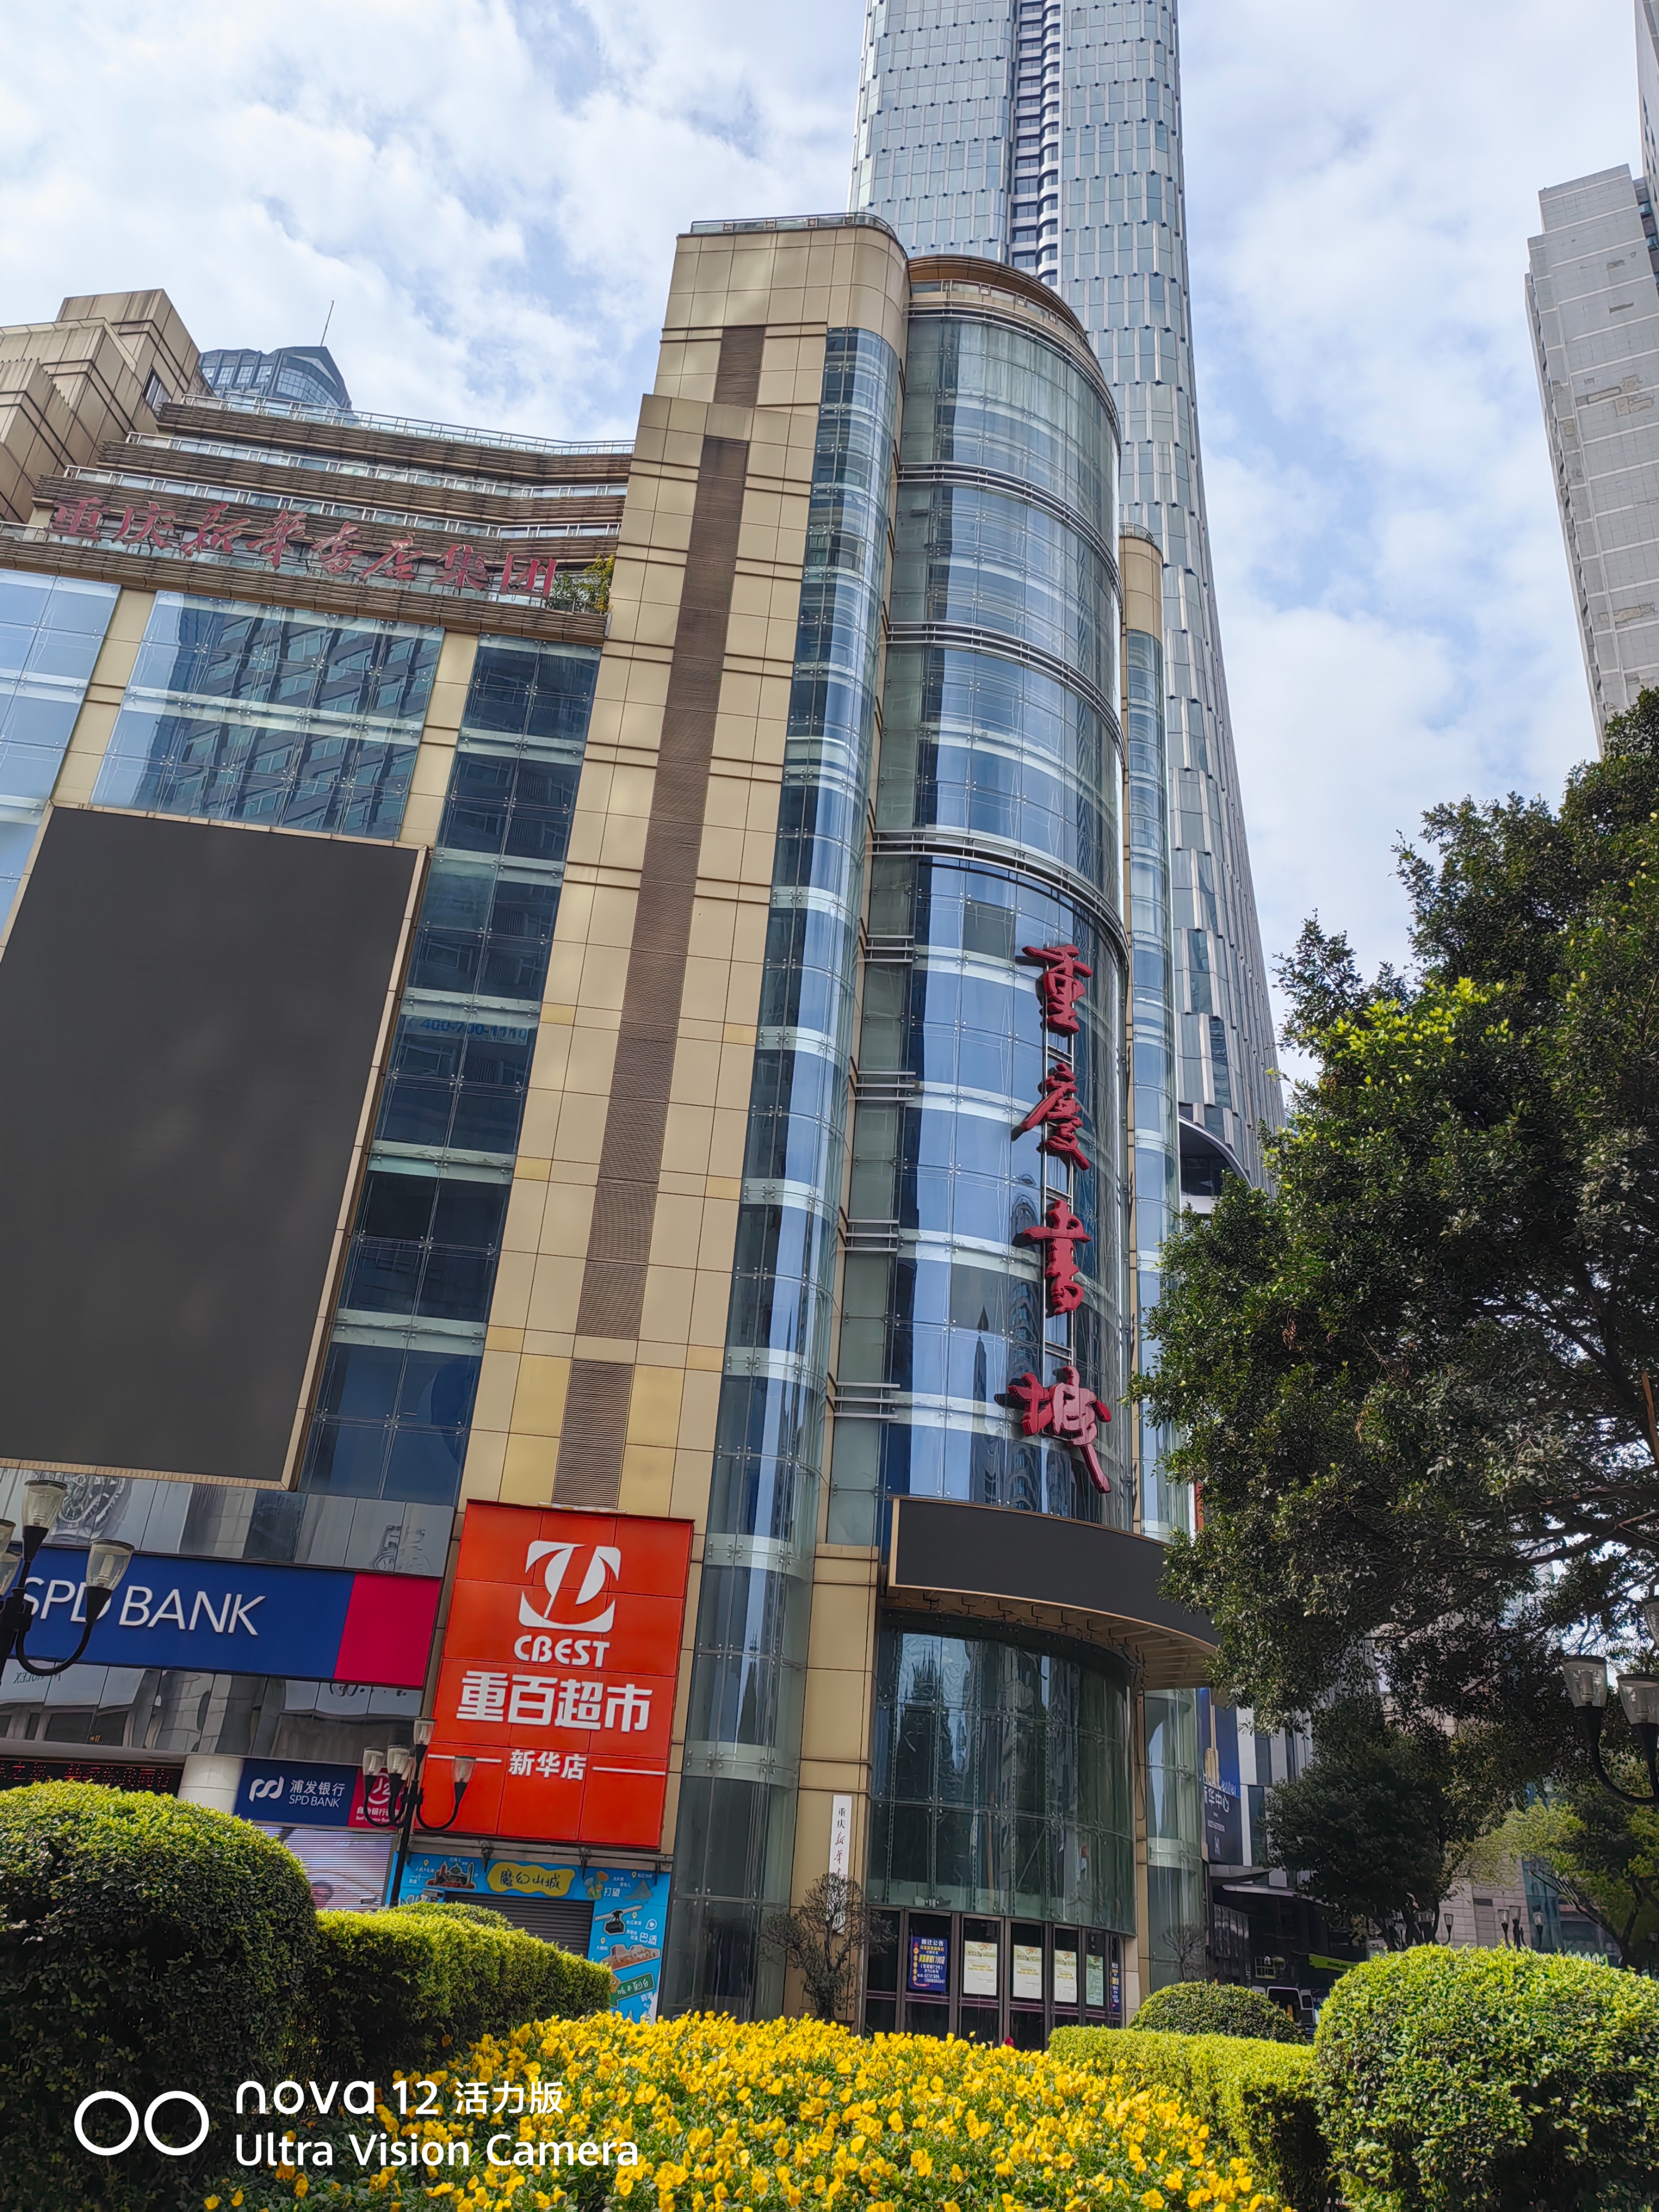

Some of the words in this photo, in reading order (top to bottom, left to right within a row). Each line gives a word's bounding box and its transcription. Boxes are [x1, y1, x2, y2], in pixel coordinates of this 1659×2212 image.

[119, 1585, 266, 1636] BANK
[514, 1634, 610, 1668] CBEST
[456, 1671, 653, 1733] 重百超市
[508, 1749, 587, 1781] 新华店
[289, 1779, 346, 1797] 浦发银行
[289, 1794, 309, 1805] SPD
[311, 1796, 341, 1808] BANK
[501, 1868, 561, 1889] 魔幻山城
